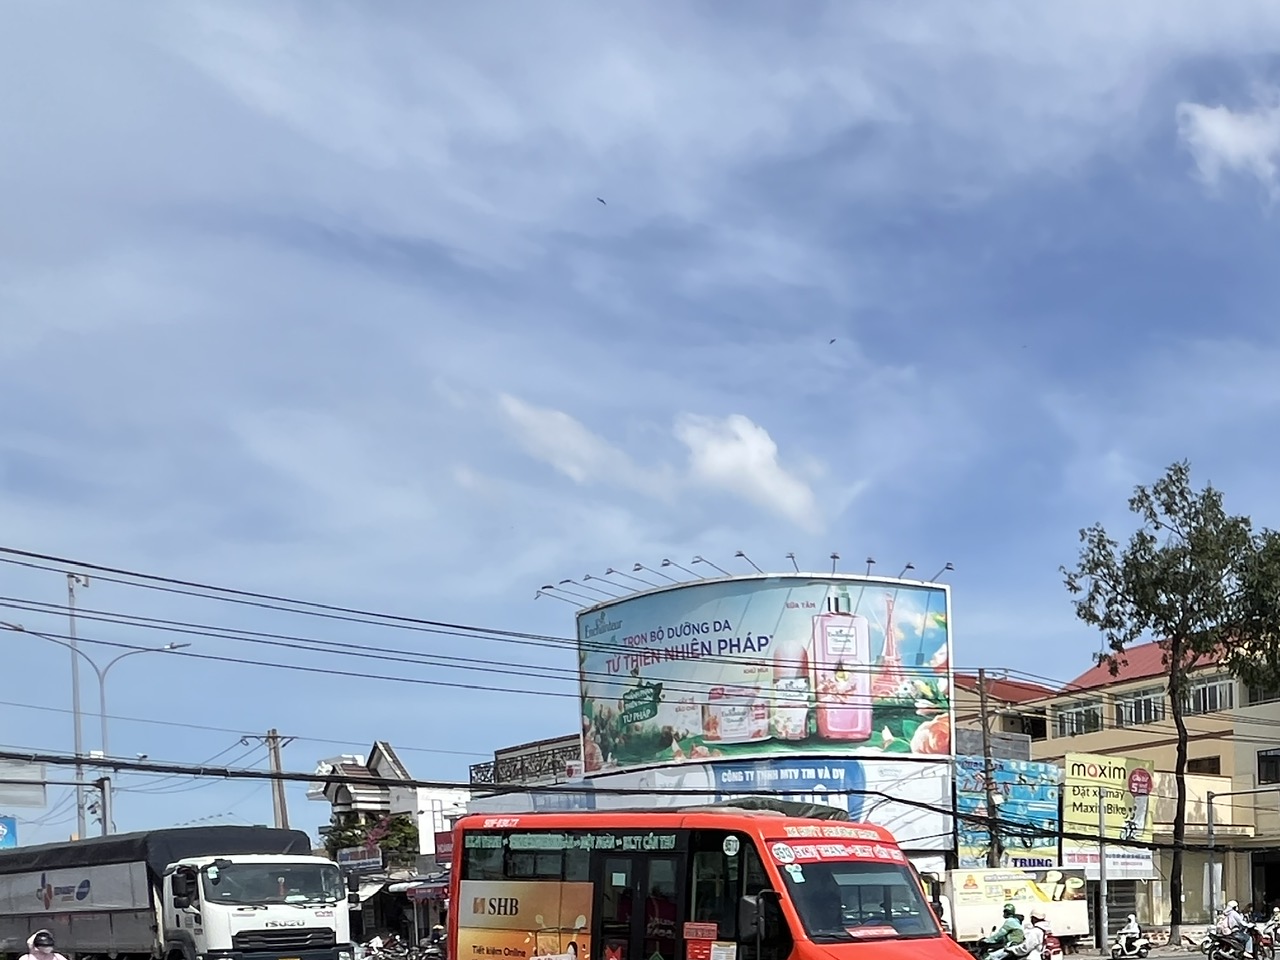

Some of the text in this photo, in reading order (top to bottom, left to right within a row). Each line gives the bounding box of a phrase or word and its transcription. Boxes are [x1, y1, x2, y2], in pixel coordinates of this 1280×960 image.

[651, 626, 665, 644] BỘ
[668, 622, 710, 639] DƯỠNG
[713, 619, 733, 633] DA
[745, 770, 756, 782] TY
[780, 768, 799, 780] MTV
[1071, 761, 1127, 780] maxim
[488, 897, 519, 916] SHB
[265, 920, 305, 928] ISUZU
[503, 948, 526, 958] Online
